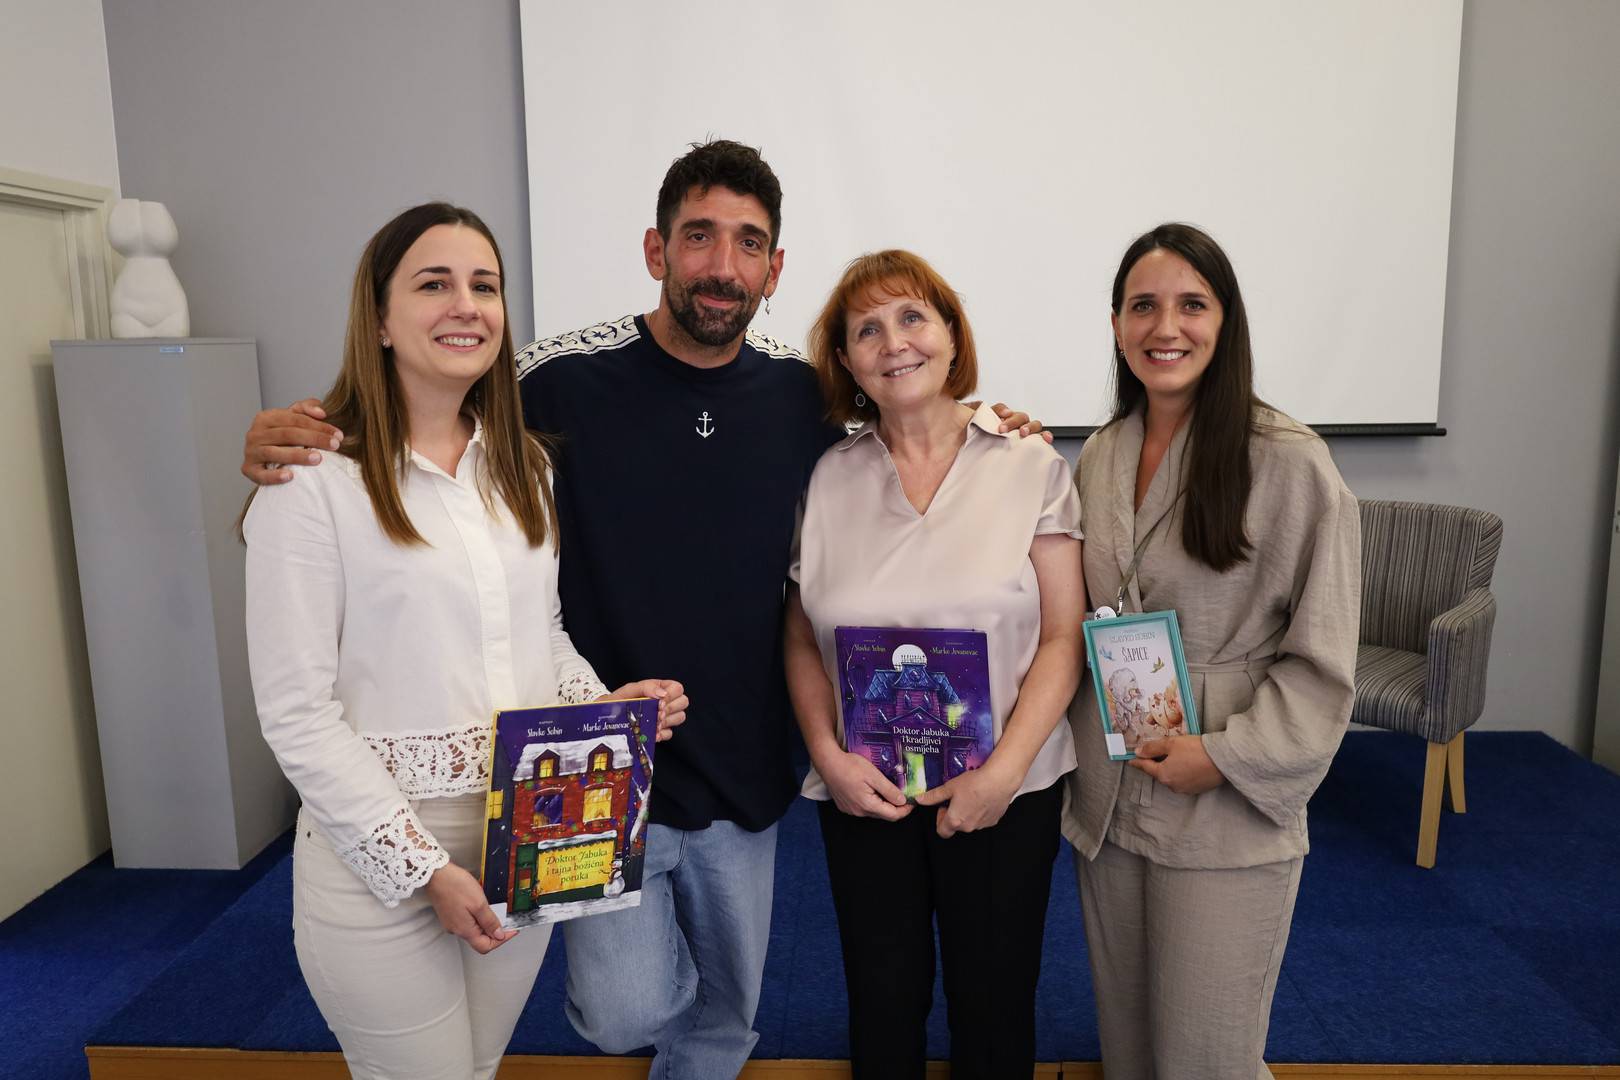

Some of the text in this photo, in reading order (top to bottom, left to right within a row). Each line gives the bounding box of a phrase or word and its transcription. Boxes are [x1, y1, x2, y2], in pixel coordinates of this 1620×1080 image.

[1121, 646, 1149, 663] ŠAPICE
[582, 722, 601, 732] Marko
[893, 726, 950, 737] Doktor Jabuka
[906, 735, 941, 746] kradljivci
[905, 745, 940, 754] osmijeha
[545, 848, 608, 865] Doktor Jabuka
[551, 865, 572, 876] tajna
[560, 871, 589, 886] poruka
